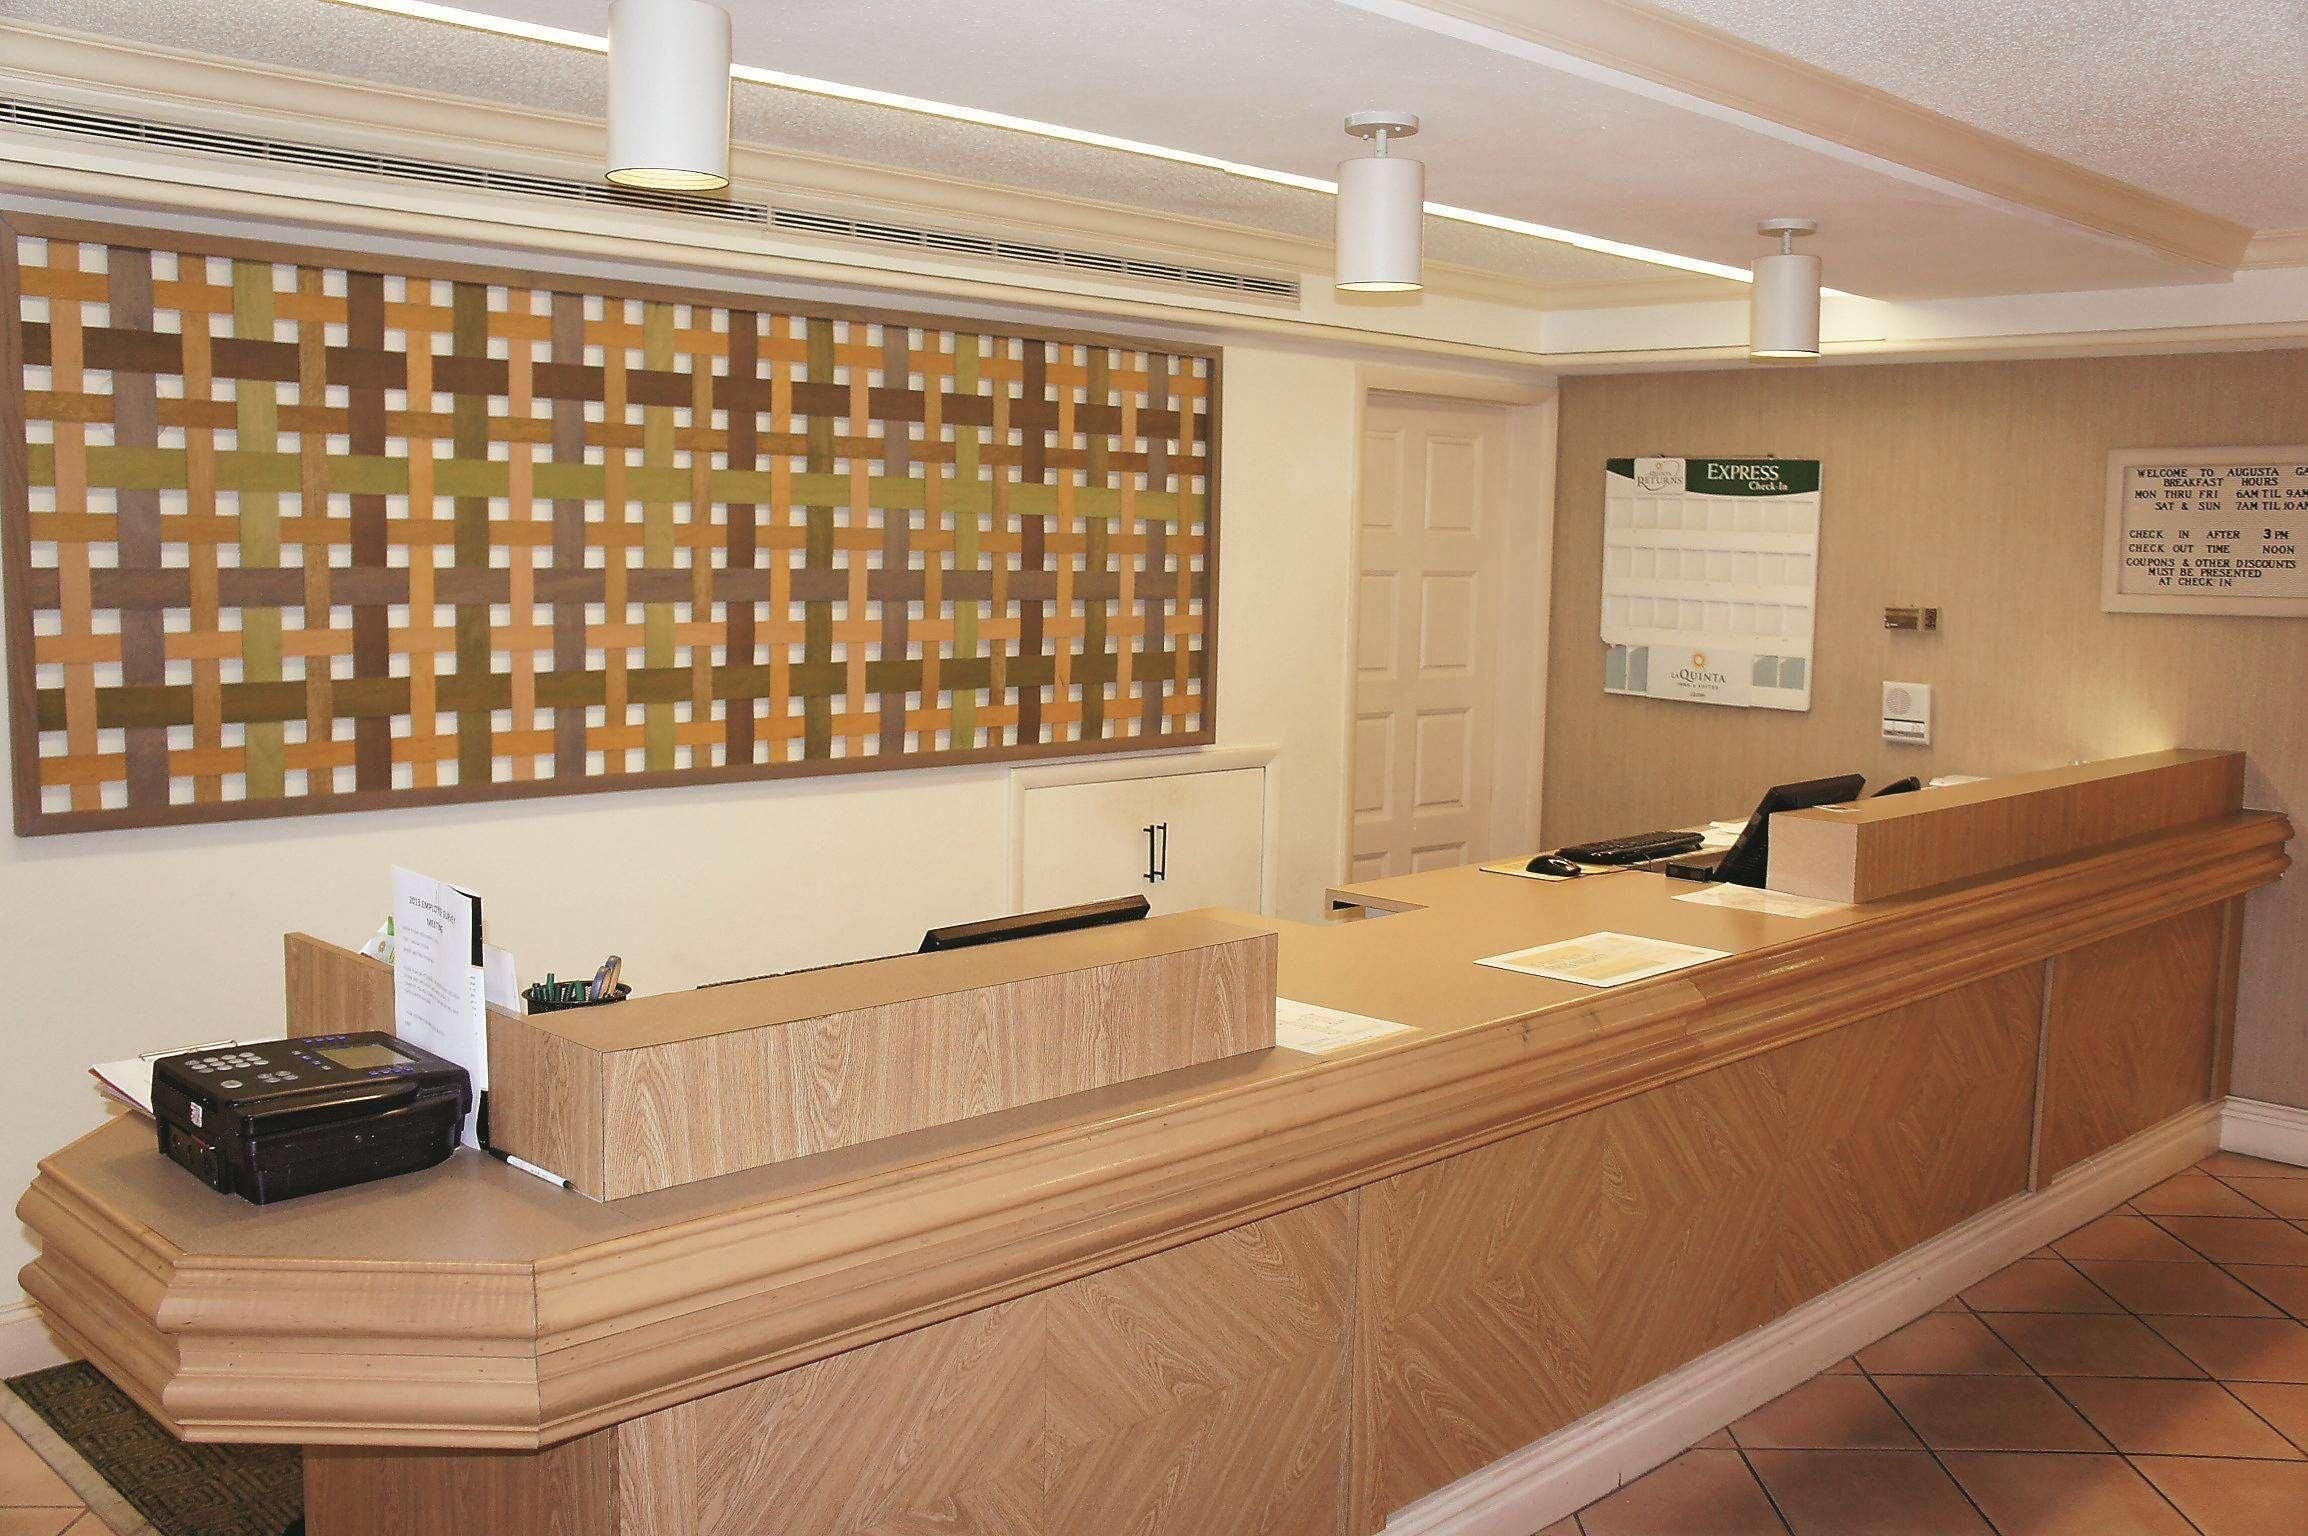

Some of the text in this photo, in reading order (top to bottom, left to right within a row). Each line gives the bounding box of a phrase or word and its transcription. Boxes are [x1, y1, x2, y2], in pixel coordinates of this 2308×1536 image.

[1707, 462, 1780, 481] EXPRESS
[2137, 468, 2188, 478] WELCOME
[2200, 468, 2214, 478] TO
[2227, 467, 2279, 477] AUGUSTA
[2163, 477, 2278, 487] BREAKFAST HOURS
[2134, 489, 2157, 499] MON
[2164, 489, 2192, 499] THRU
[2199, 489, 2218, 499] FRI
[2236, 489, 2259, 499] 6AM
[2261, 489, 2281, 499] TIL
[2155, 501, 2175, 511] SAT
[2181, 501, 2189, 511] &
[2198, 501, 2221, 511] SUN
[2236, 501, 2258, 511] 7AM
[2262, 501, 2281, 511] TIL
[2129, 528, 2290, 540] CHECK IN AFTER 3 PM
[2128, 543, 2295, 555] CHECK OUT TIME NOON
[2126, 557, 2296, 569] COUPONS & OTHER DISCOUNTS
[2148, 567, 2262, 578] MUST BE PRESENTED
[2159, 576, 2232, 587] AT CHECK IN
